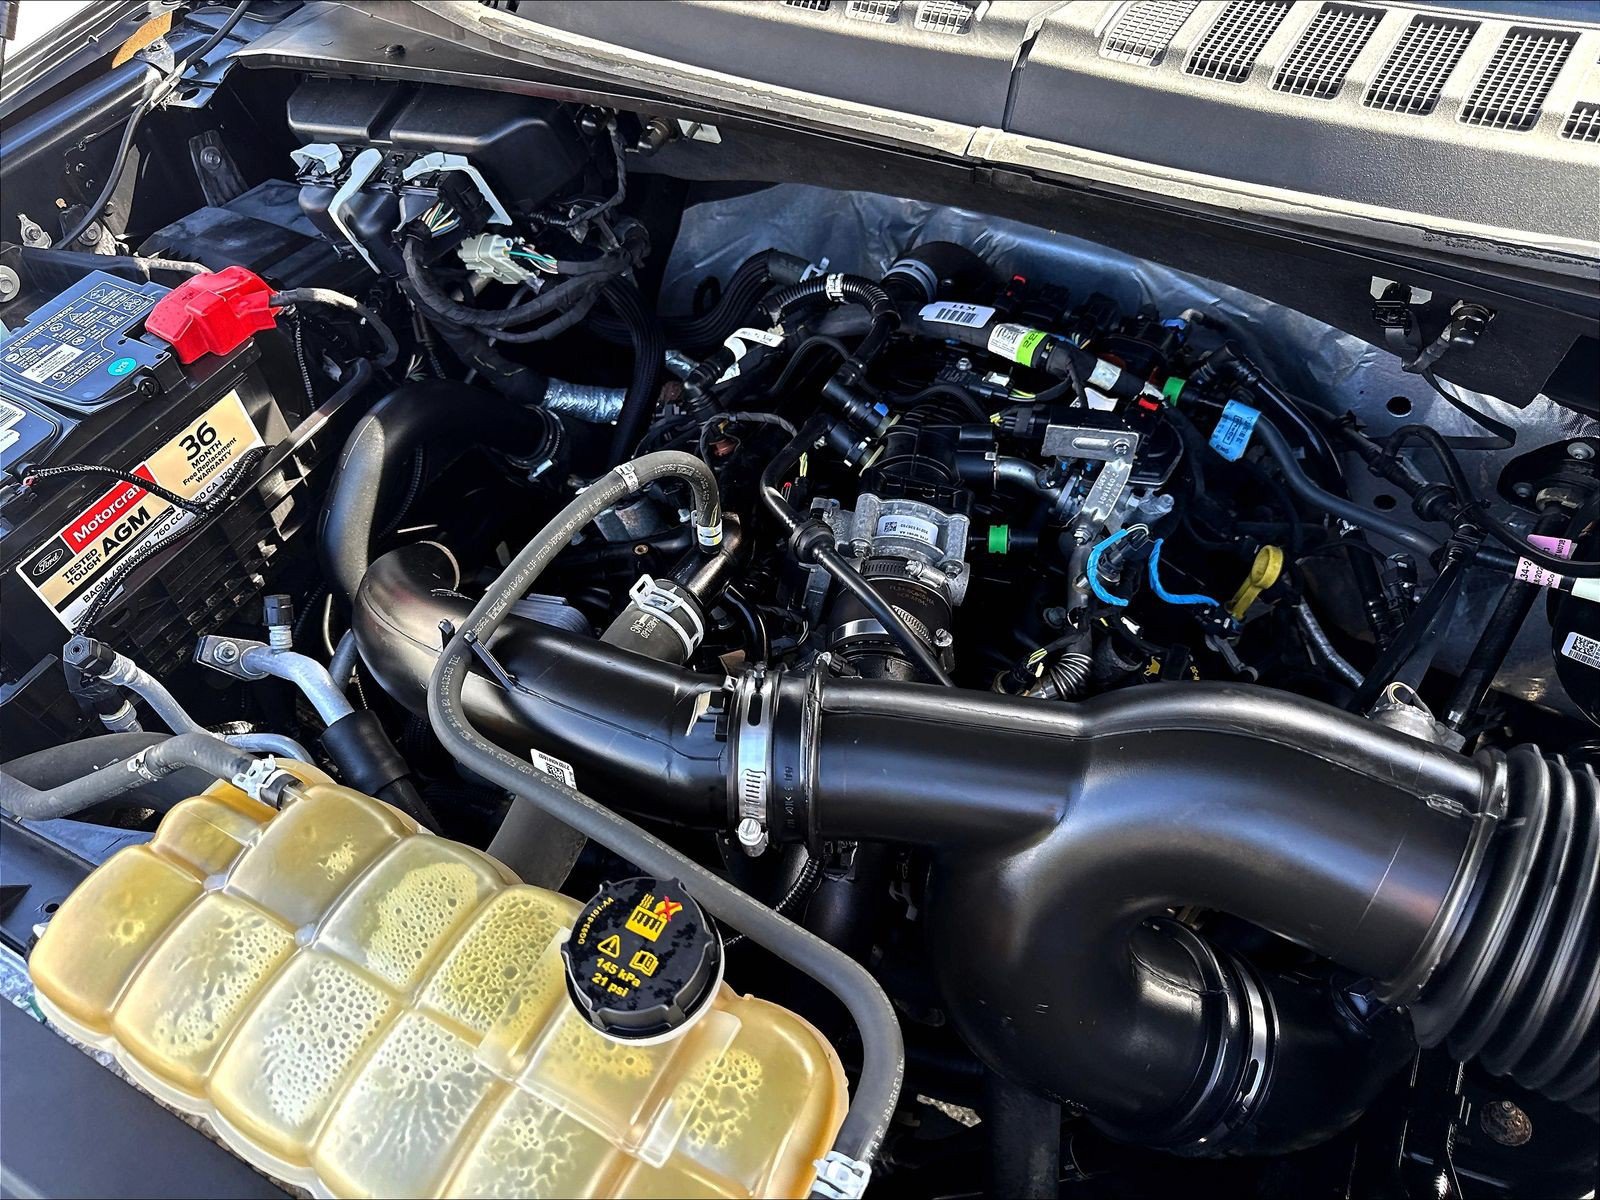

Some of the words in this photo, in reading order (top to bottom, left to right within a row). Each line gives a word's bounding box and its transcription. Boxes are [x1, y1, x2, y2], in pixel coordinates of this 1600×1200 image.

[176, 419, 219, 462] 36
[190, 439, 222, 469] MONTH
[182, 470, 198, 485] Free
[195, 436, 237, 473] Replacement
[194, 449, 233, 483] WARRANTY
[153, 523, 171, 540] 760
[170, 508, 188, 526] CCA
[204, 480, 218, 494] CA
[97, 505, 152, 556] AGM
[34, 548, 62, 576] Ford
[62, 548, 98, 580] TESTED
[592, 973, 608, 986] 21
[608, 982, 629, 997] psi
[597, 958, 619, 975] 145
[618, 969, 641, 987] kPa
